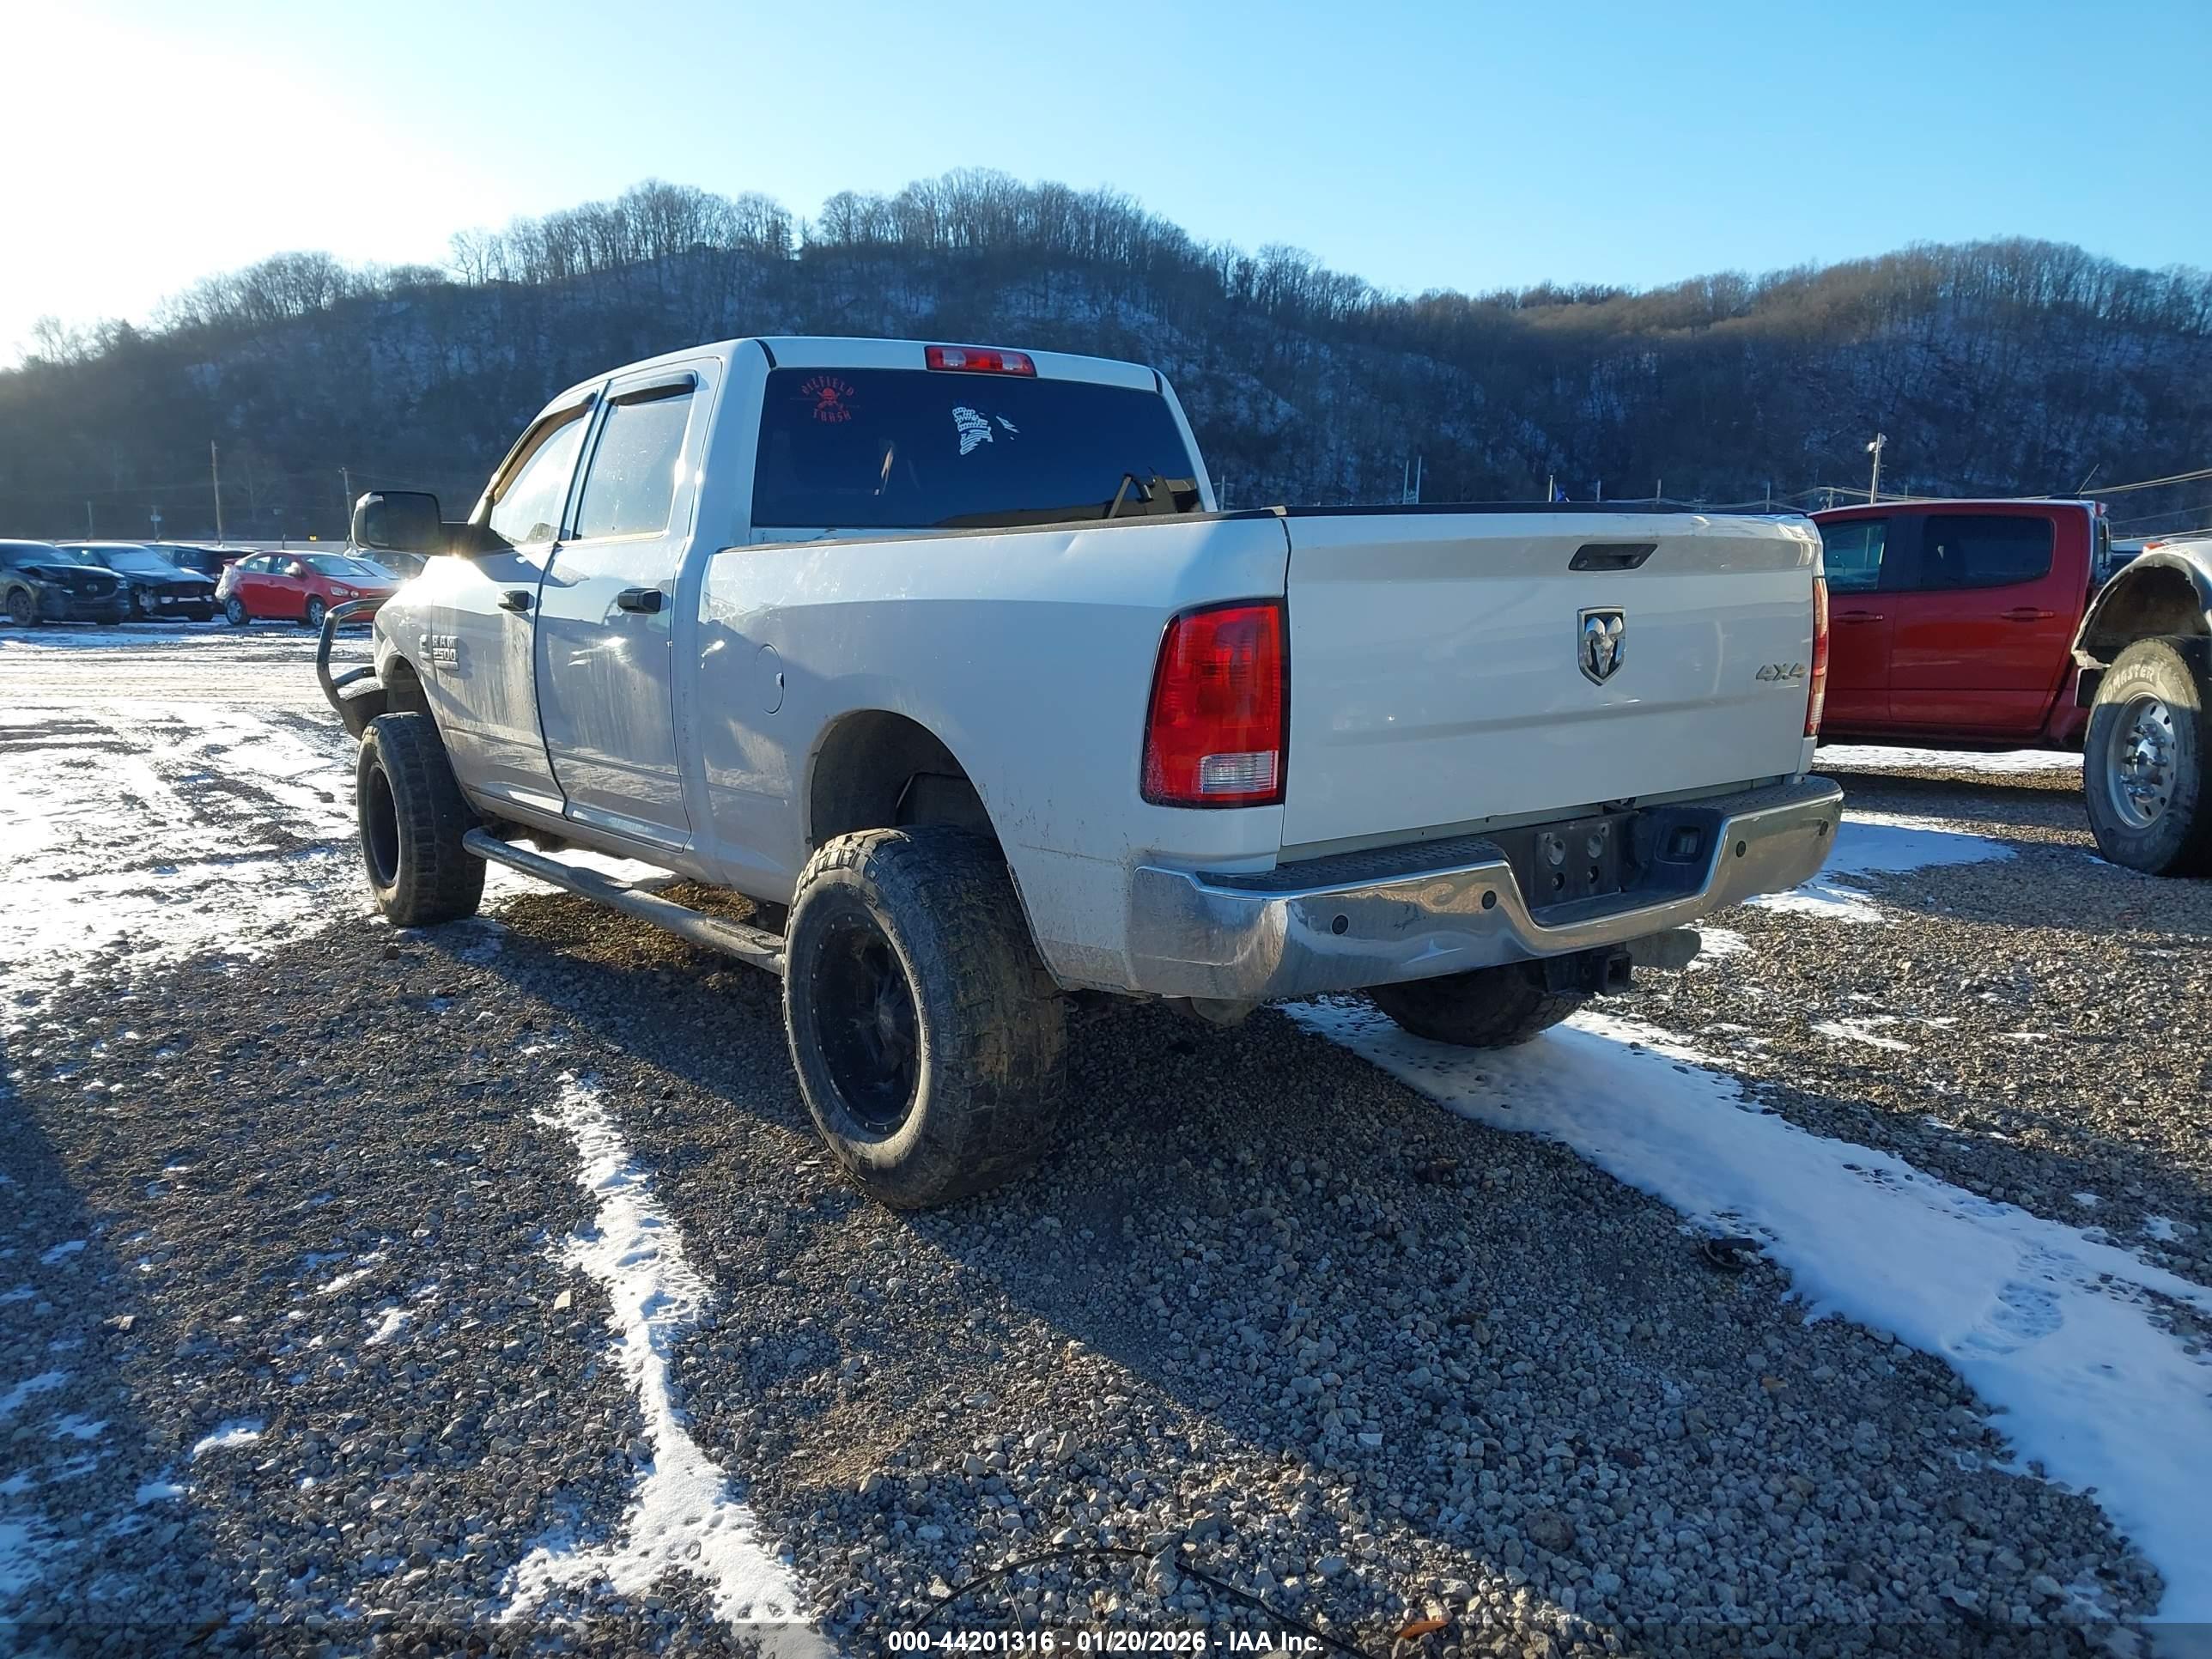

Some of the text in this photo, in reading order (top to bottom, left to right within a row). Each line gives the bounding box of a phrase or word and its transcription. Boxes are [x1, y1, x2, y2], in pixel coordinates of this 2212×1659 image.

[813, 408, 851, 422] TRASH
[432, 635, 459, 647] RAM
[433, 647, 456, 660] 2500
